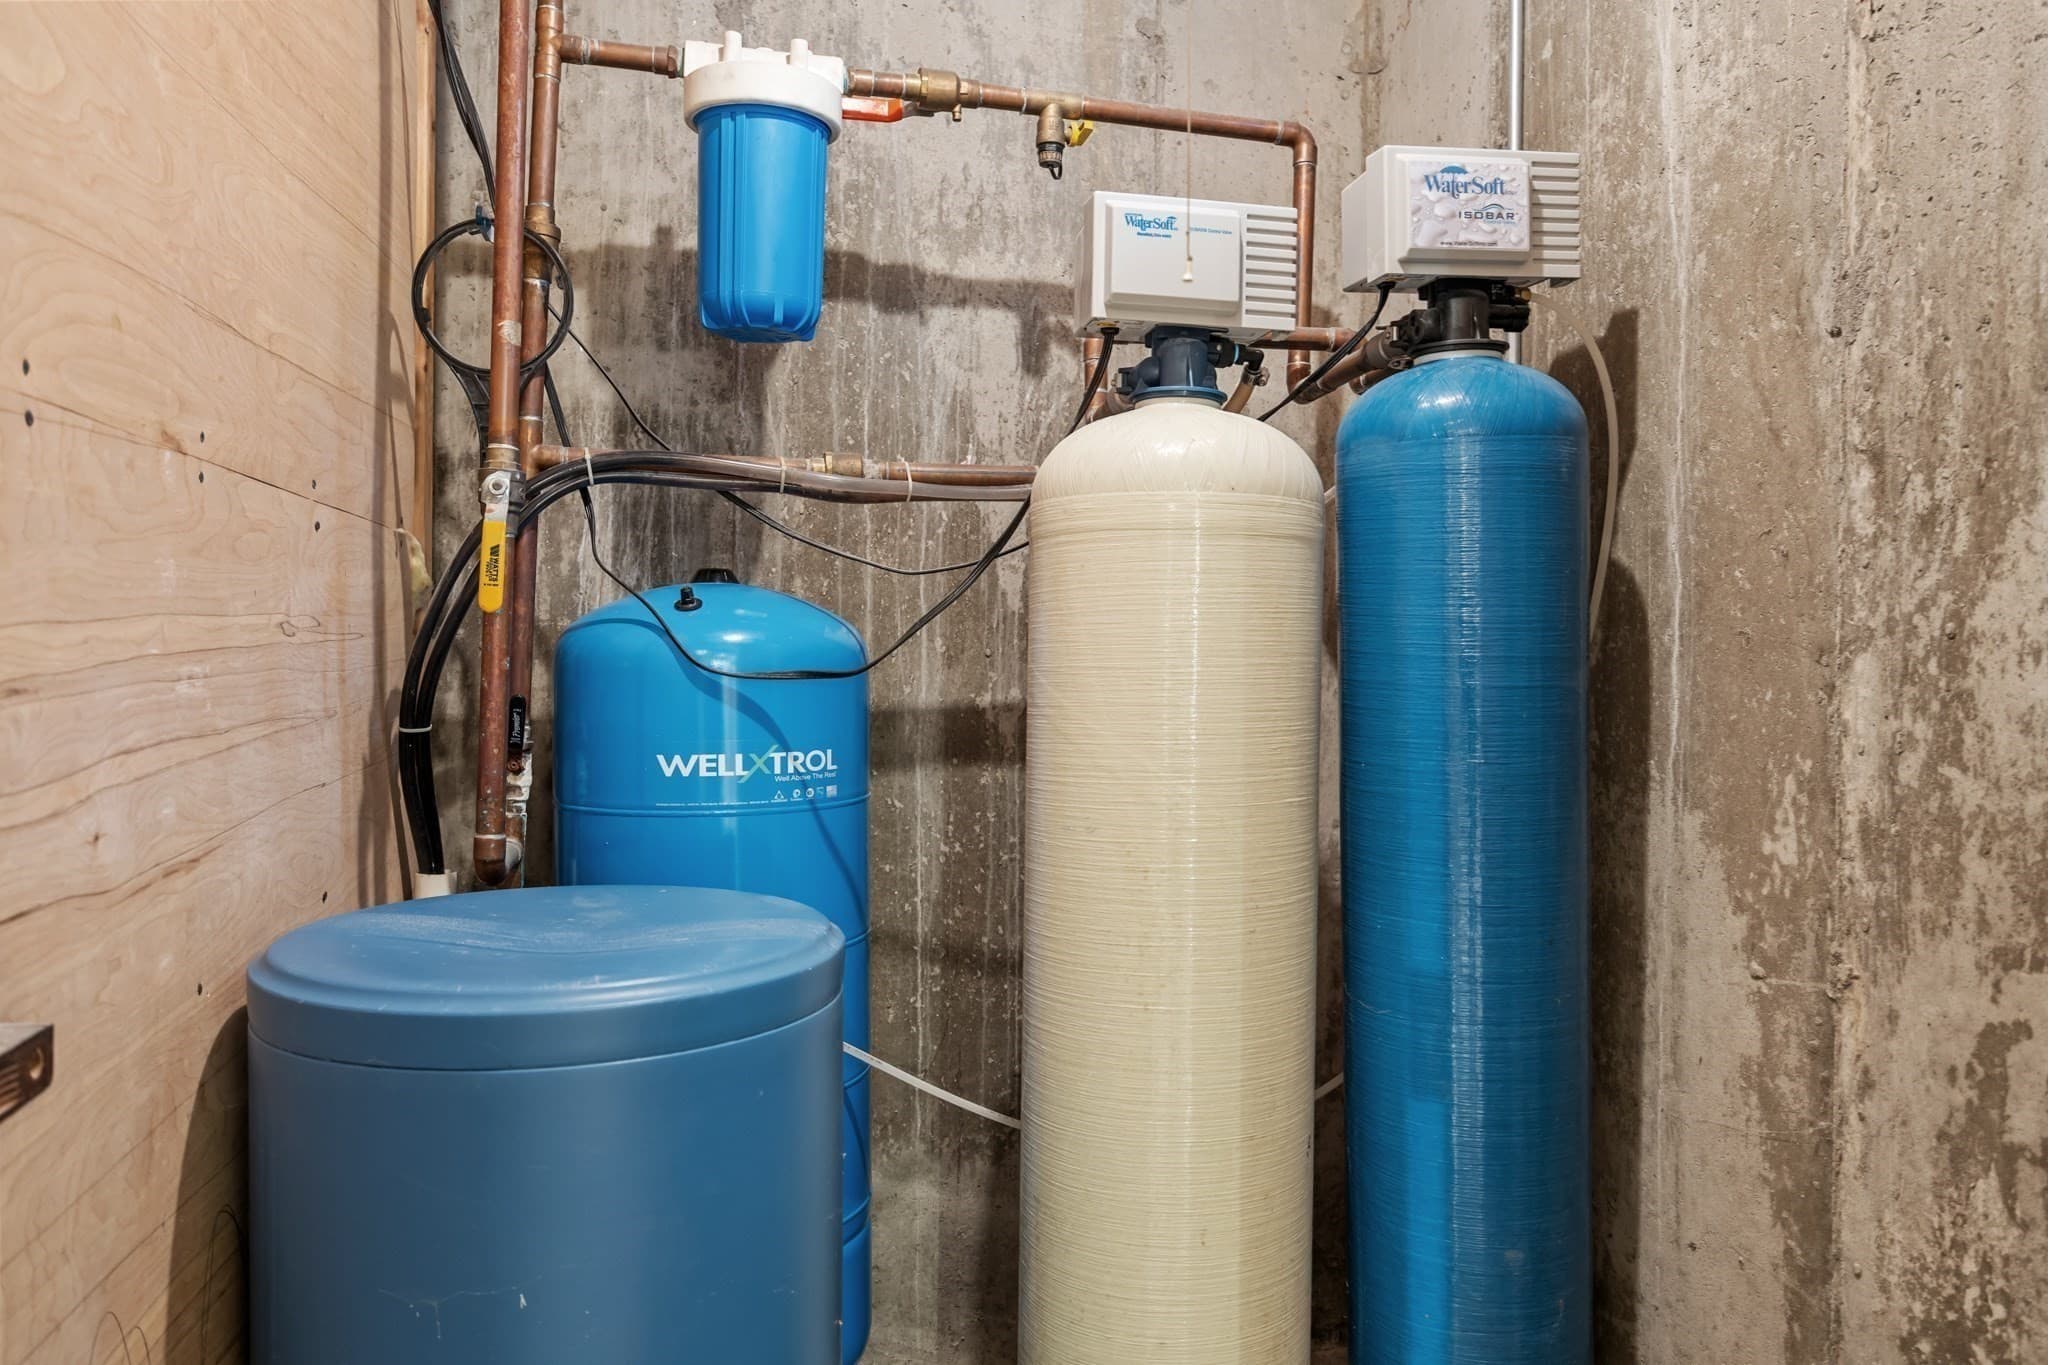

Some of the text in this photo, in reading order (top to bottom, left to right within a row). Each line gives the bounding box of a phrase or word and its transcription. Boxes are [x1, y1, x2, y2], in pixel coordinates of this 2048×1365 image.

[1424, 174, 1505, 199] WaterSoft
[1124, 213, 1177, 231] WaterSoft
[1458, 211, 1515, 220] ISOBAR
